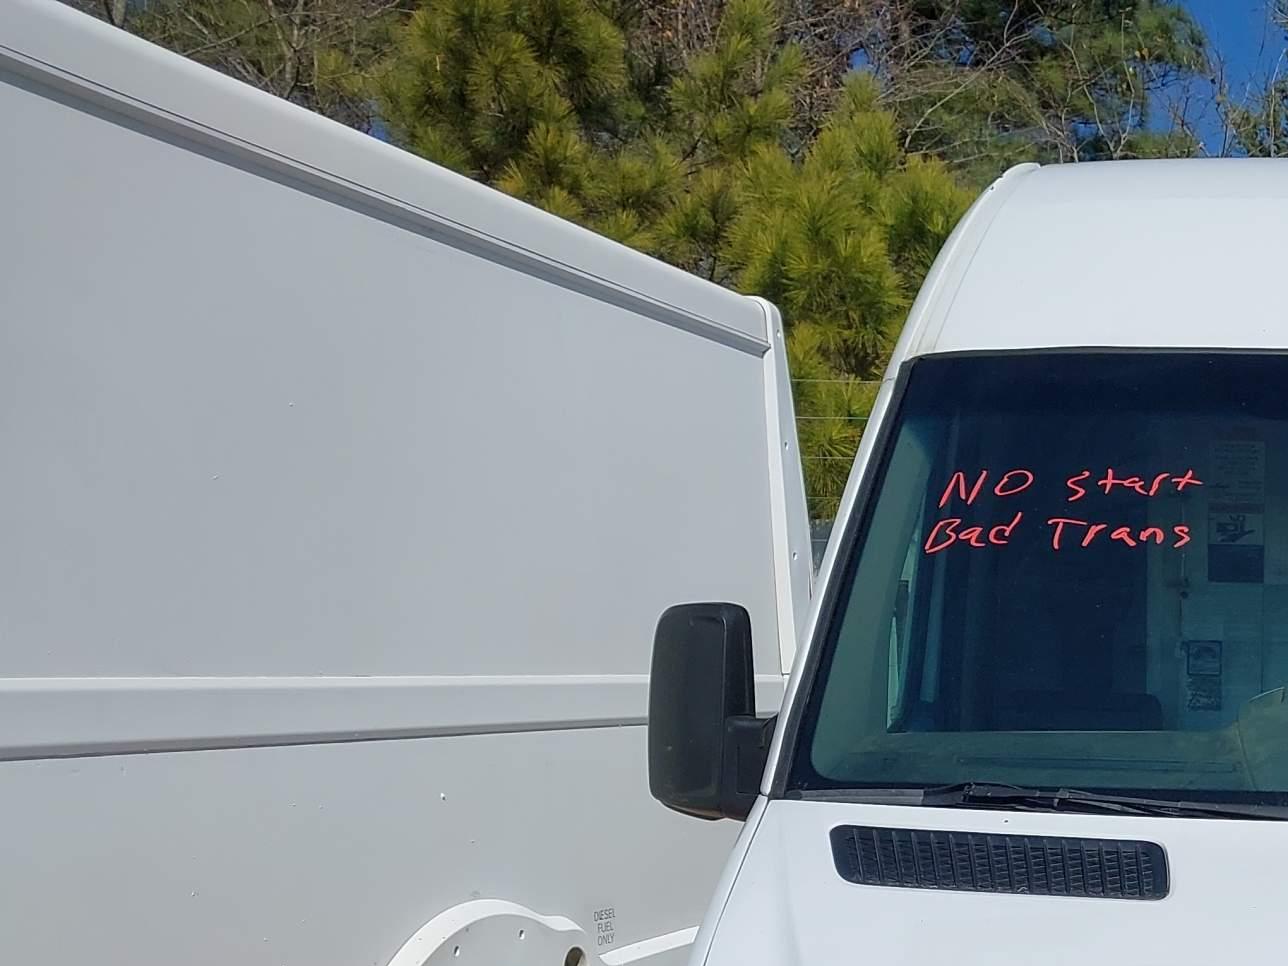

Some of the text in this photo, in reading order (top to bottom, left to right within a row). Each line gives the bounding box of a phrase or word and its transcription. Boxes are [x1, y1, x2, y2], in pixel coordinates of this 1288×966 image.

[939, 470, 1034, 508] NO
[925, 512, 1191, 553] Bad Trans
[594, 908, 615, 921] DIESEL
[597, 921, 614, 933] FUEL
[597, 932, 615, 946] ONLY
